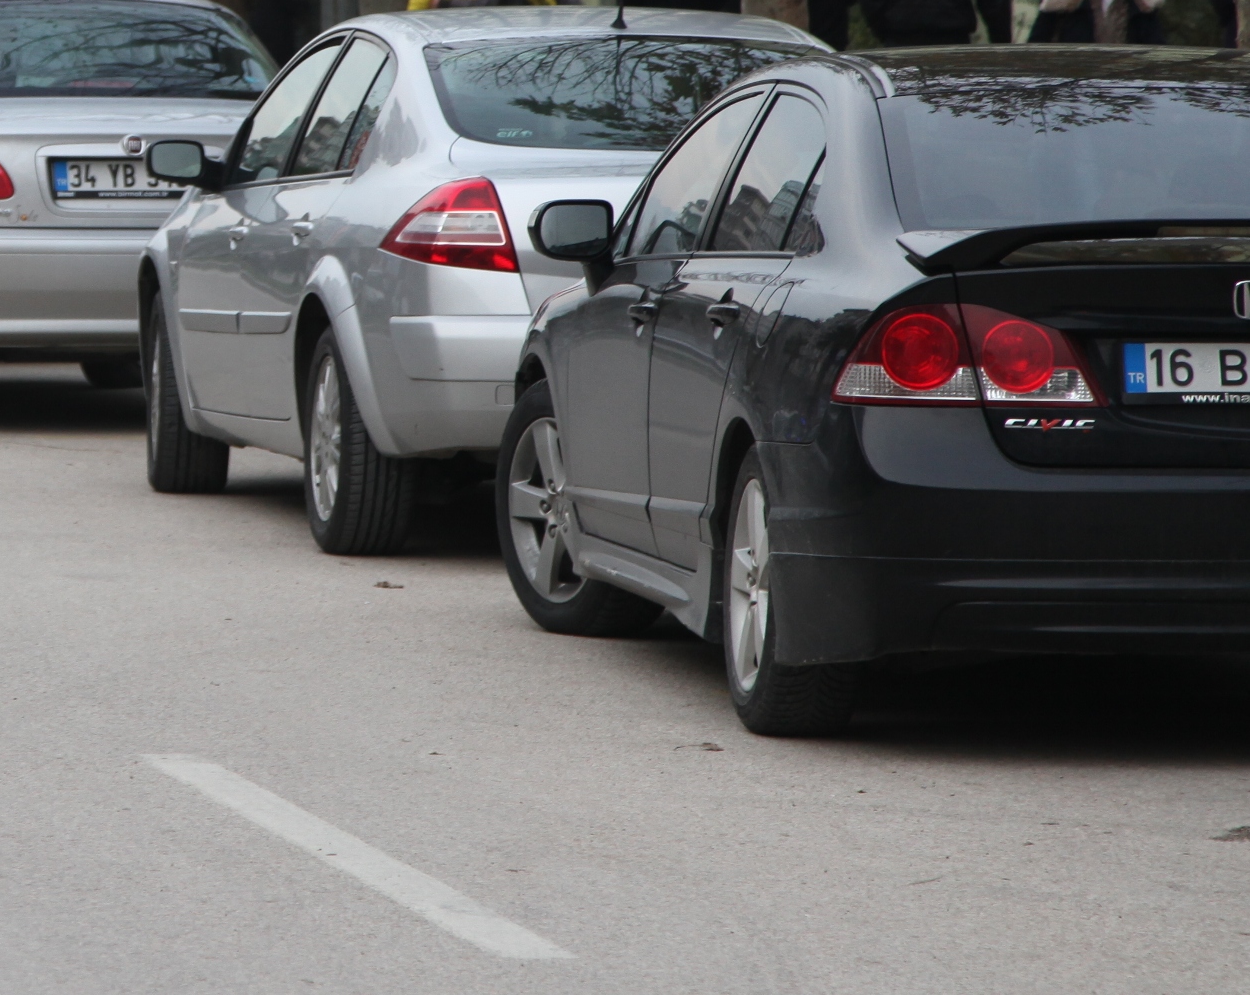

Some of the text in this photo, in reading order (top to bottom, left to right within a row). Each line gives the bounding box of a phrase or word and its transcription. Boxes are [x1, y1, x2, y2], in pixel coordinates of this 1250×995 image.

[68, 164, 96, 188] 34
[108, 163, 136, 188] YB
[1150, 348, 1249, 388] 16 B
[1128, 372, 1145, 384] TR
[1004, 418, 1096, 432] CIVIC
